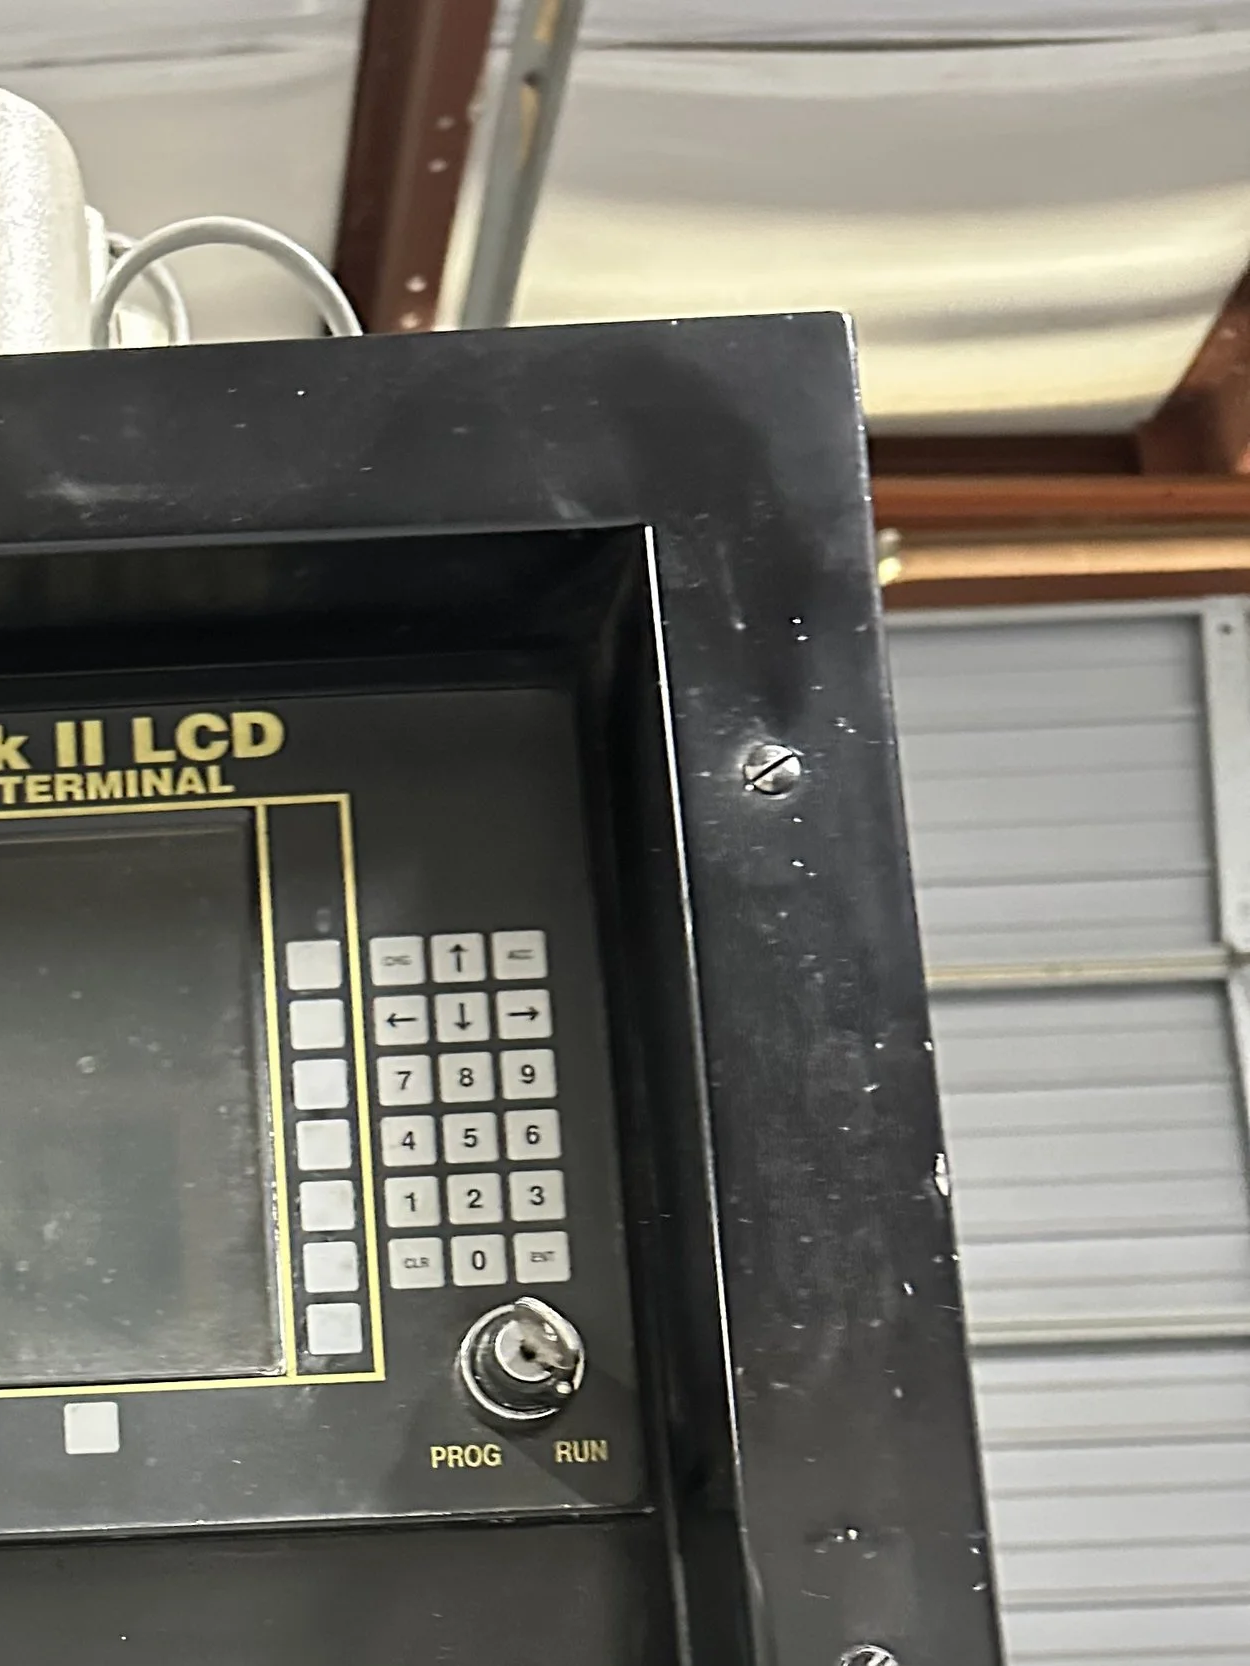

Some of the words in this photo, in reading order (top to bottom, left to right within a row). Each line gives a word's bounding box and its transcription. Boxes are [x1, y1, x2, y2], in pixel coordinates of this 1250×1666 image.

[54, 719, 104, 769] II
[131, 710, 286, 764] LCD
[397, 1070, 412, 1091] 7
[458, 1066, 475, 1088] 8
[520, 1063, 536, 1085] 9
[400, 1130, 417, 1151] 4
[462, 1127, 479, 1149] 5
[524, 1124, 541, 1146] 6
[405, 1192, 417, 1213] 1
[466, 1188, 484, 1210] 2
[529, 1184, 546, 1206] 3
[403, 1256, 430, 1269] CLR
[471, 1250, 487, 1271] 0
[430, 1444, 503, 1469] PROG
[554, 1439, 609, 1464] RUN
